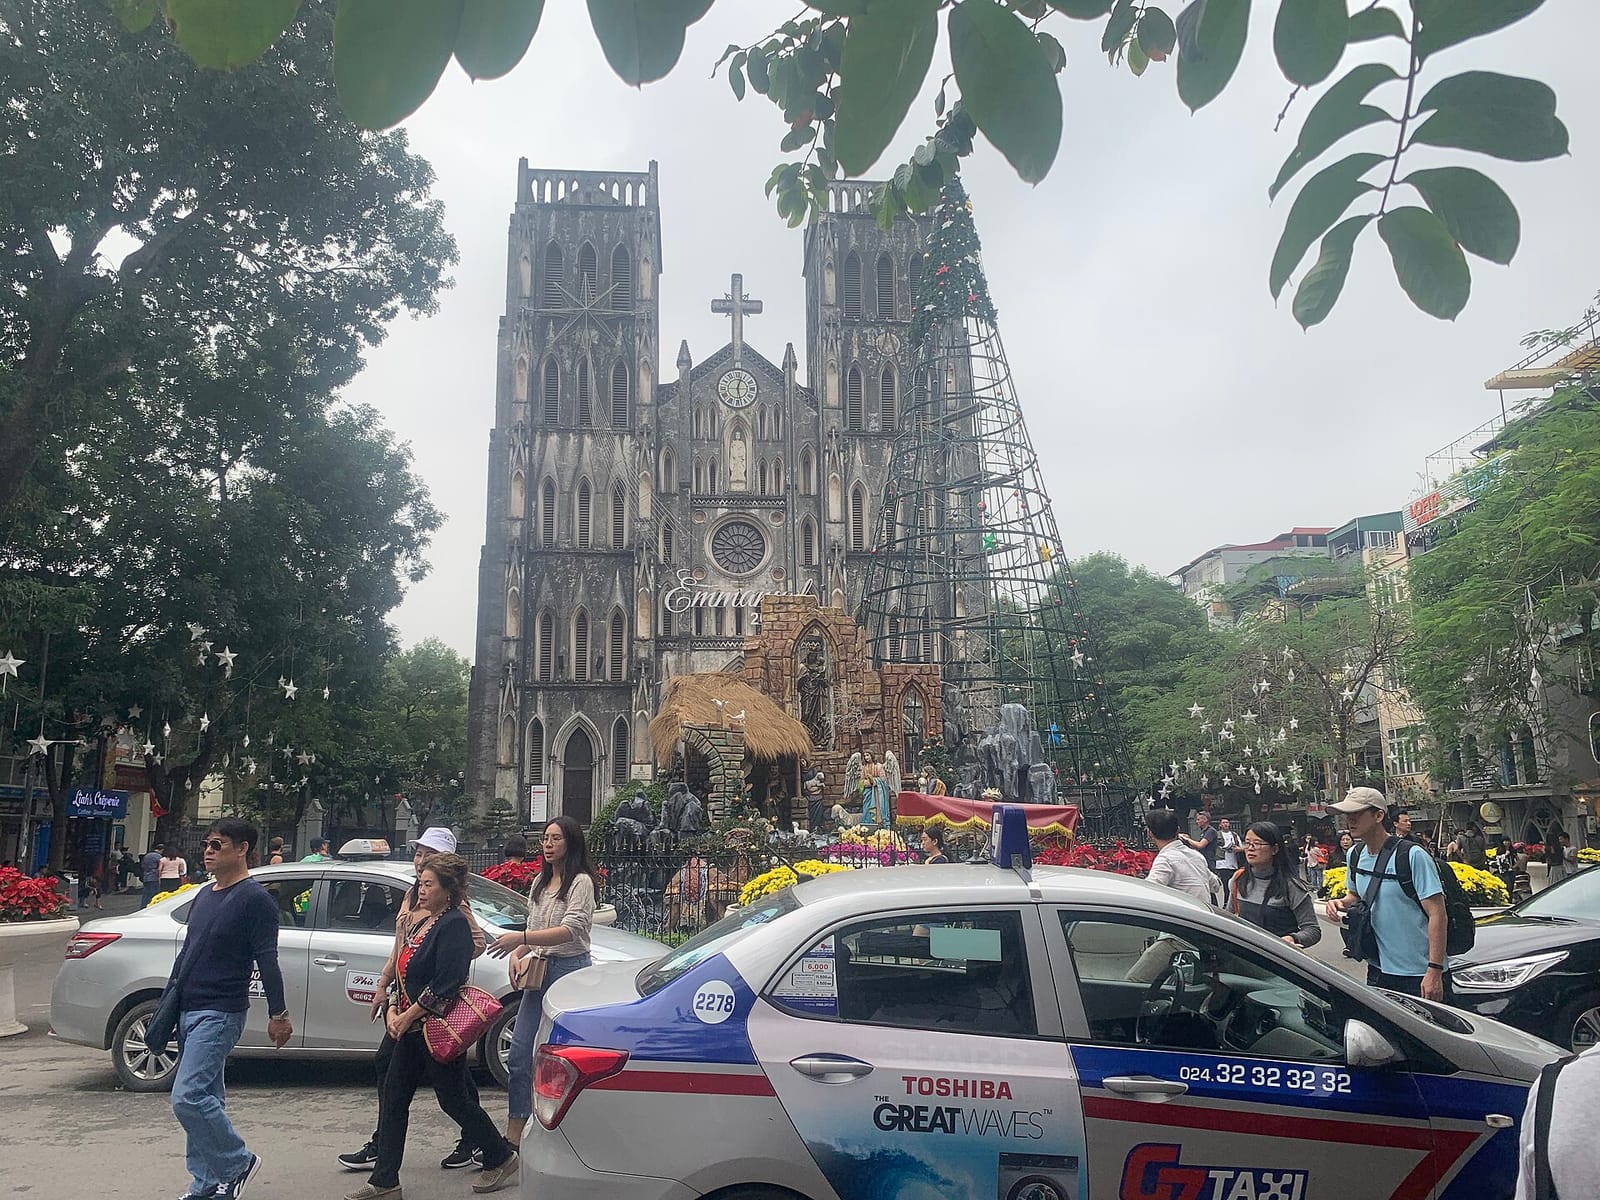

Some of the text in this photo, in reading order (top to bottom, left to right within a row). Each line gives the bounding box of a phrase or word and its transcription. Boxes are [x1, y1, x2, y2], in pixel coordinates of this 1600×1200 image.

[696, 993, 734, 1012] 2278
[901, 1076, 1013, 1101] TOSHIBA
[1251, 1066, 1281, 1088] 32
[1286, 1069, 1316, 1091] 32
[1321, 1072, 1352, 1094] 32
[1208, 1170, 1306, 1200] TAXI
